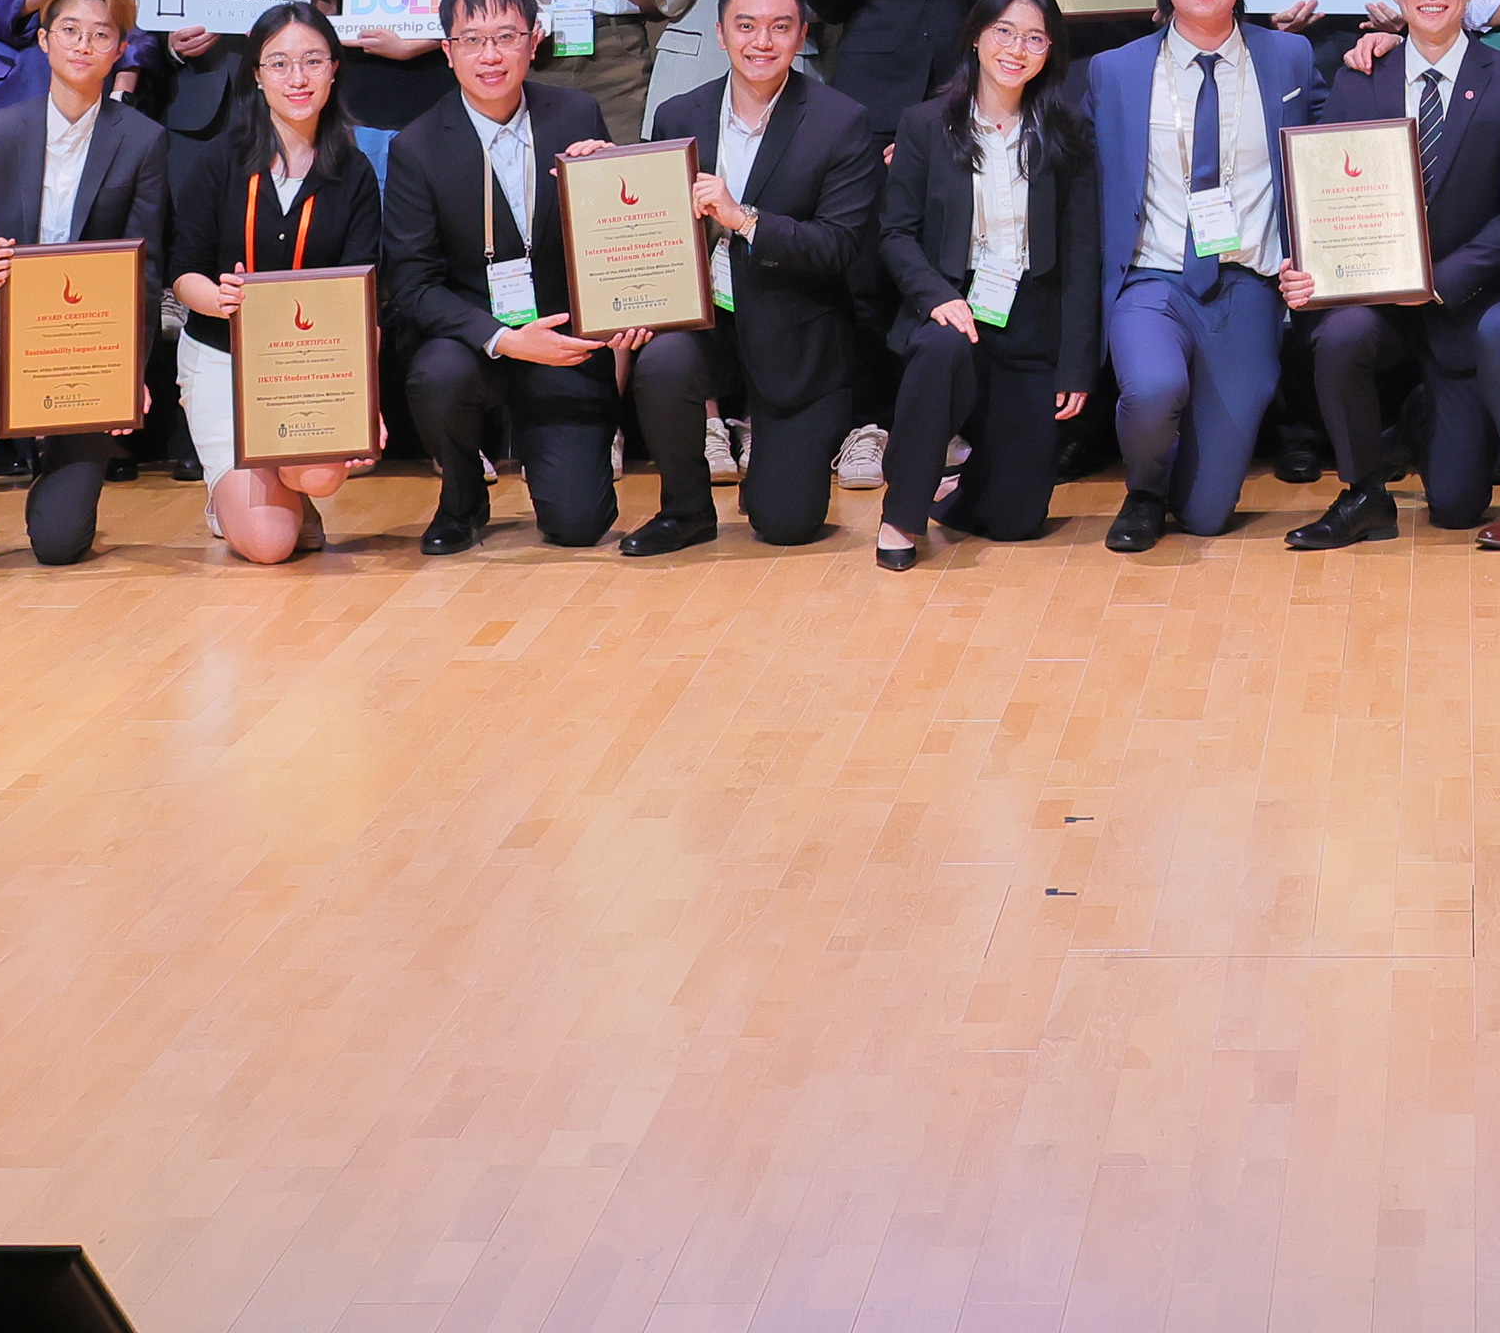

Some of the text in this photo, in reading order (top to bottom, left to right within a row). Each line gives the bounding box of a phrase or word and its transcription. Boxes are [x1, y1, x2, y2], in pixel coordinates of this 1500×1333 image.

[1357, 212, 1384, 220] Student
[1358, 221, 1383, 229] Award
[584, 239, 684, 256] International Student Track
[606, 250, 664, 263] Platinum Award
[98, 343, 120, 351] Award
[258, 375, 283, 384] HKUST
[284, 373, 311, 382] Student
[330, 371, 353, 379] Award
